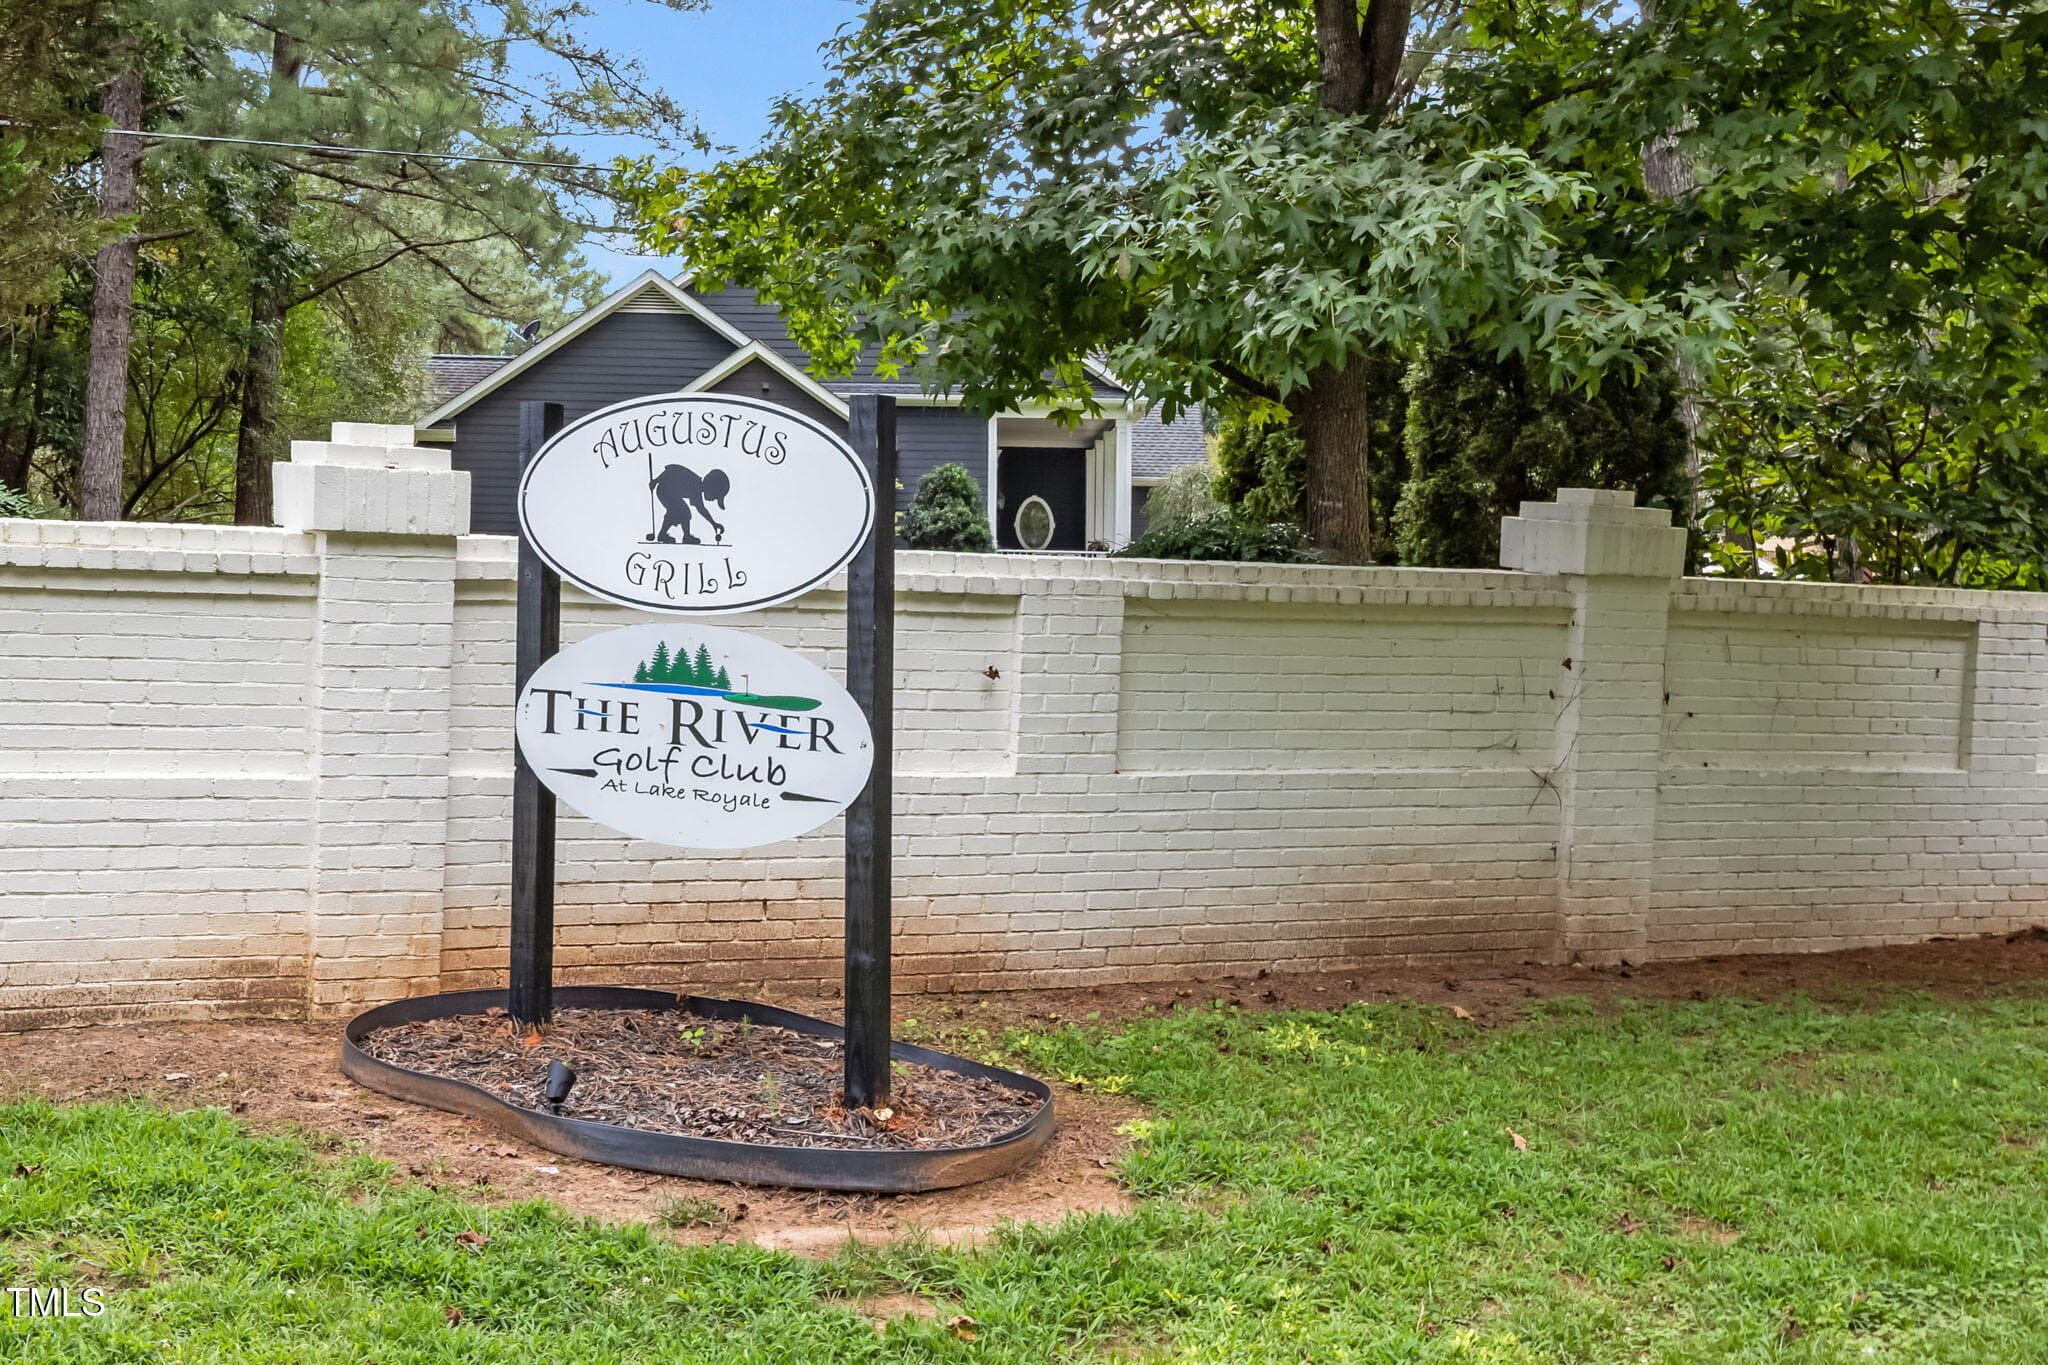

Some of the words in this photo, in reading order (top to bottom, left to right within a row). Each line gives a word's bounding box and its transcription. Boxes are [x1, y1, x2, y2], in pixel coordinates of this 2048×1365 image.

[593, 411, 788, 469] AUGUSTUS
[625, 552, 748, 600] GRILL
[593, 746, 682, 784] Golf
[691, 755, 787, 786] Club
[600, 778, 628, 793] At
[634, 781, 686, 800] Lake
[692, 788, 771, 812] Royale
